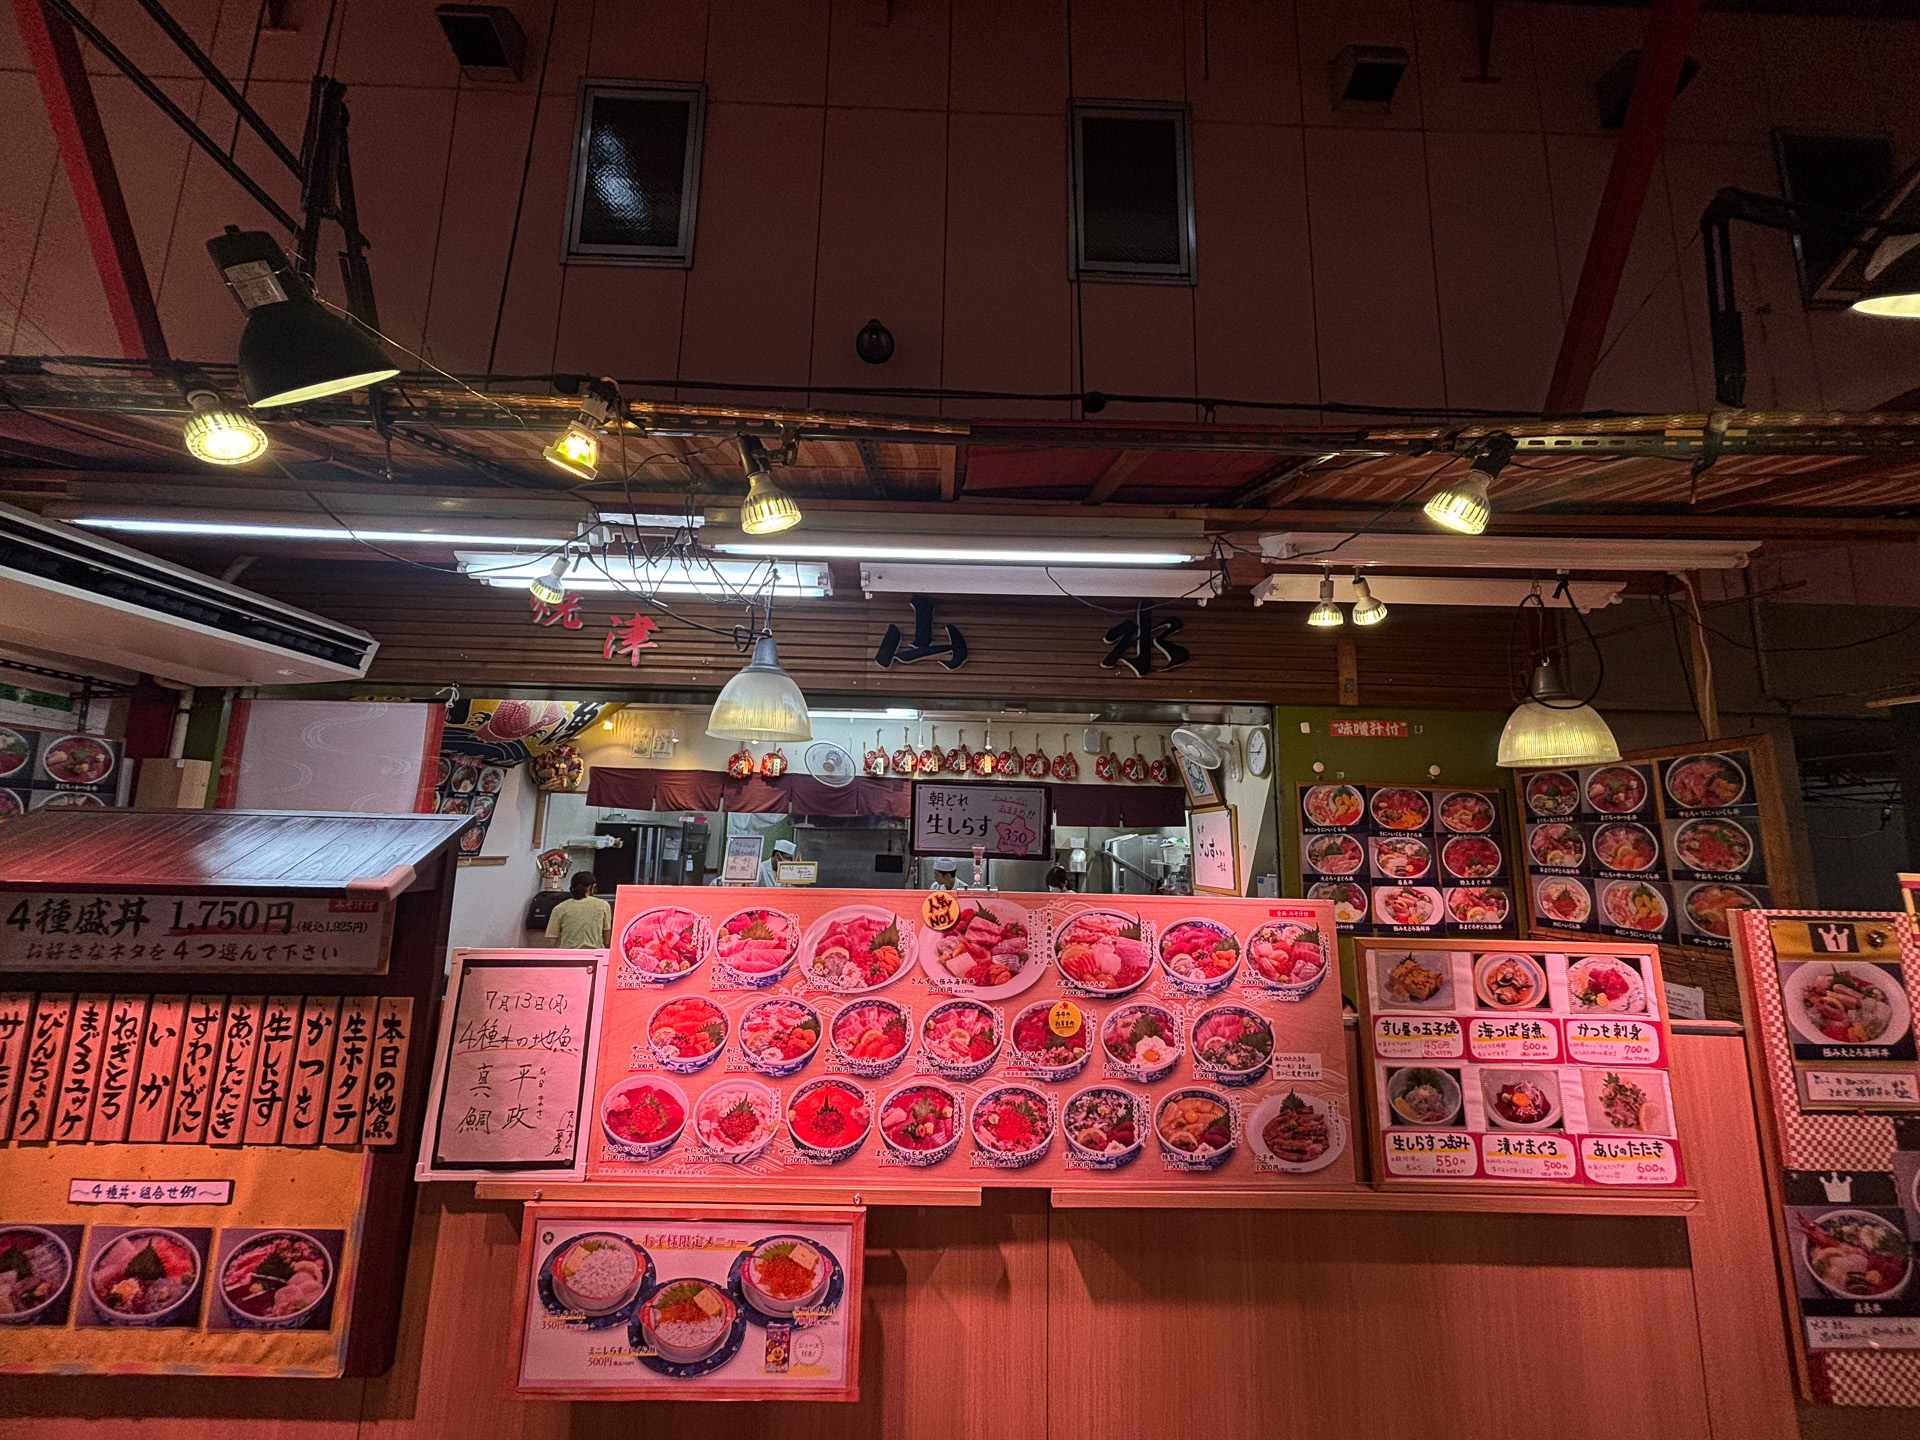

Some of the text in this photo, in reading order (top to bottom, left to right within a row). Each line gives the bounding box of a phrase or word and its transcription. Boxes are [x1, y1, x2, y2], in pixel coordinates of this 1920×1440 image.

[927, 791, 969, 807] 朝どれ
[926, 813, 992, 837] 生しらす
[1002, 828, 1028, 844] 350
[928, 894, 952, 913] 人気
[6, 897, 150, 938] 4種盛丼
[170, 899, 294, 935] 1,750円
[930, 911, 953, 928] NO1
[486, 991, 568, 1014] 7月13日(月)
[1577, 1022, 1642, 1041] かつを刺身
[20, 1011, 67, 1135] びんちょう
[59, 1006, 100, 1137] まぐろユッケ
[101, 1008, 138, 1120] ねぎとろ
[139, 1022, 176, 1112] いか
[172, 1006, 219, 1136] ずわいがに
[211, 1007, 253, 1138] あじたたき
[252, 1010, 293, 1126] 生しらす
[333, 1011, 367, 1135] 生ホタテ
[364, 1012, 406, 1138] 本日の地魚
[456, 1063, 494, 1134] 真鯛
[502, 1064, 537, 1130] 平政
[1393, 1134, 1470, 1151] 生しらすつまみ
[1497, 1137, 1558, 1156] 漬けまぐろ
[1593, 1140, 1664, 1158] あじのたたき
[642, 1233, 748, 1249] お子様限定メニュー
[542, 1321, 565, 1330] 350円
[588, 1357, 613, 1367] 500円
